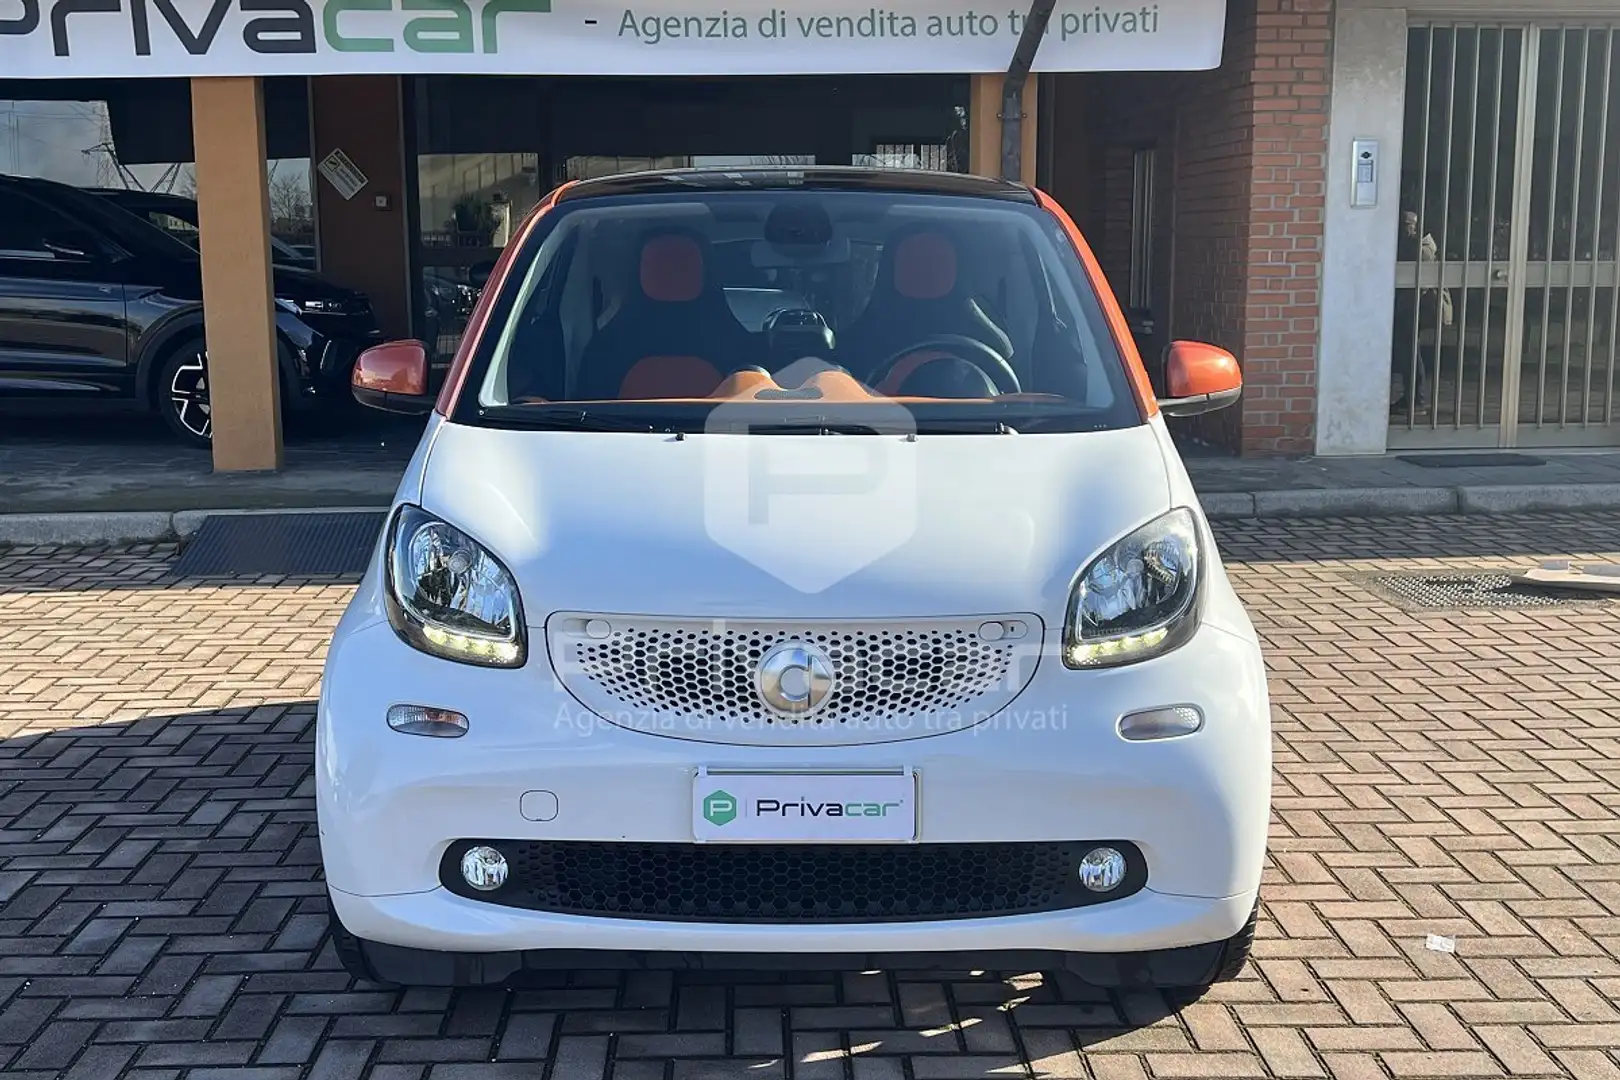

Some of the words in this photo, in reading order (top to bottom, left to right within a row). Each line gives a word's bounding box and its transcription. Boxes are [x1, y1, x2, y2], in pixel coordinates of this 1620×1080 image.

[618, 9, 748, 45] Agenzia
[757, 8, 787, 38] di
[796, 8, 917, 38] vendita
[926, 10, 999, 37] auto
[1060, 5, 1159, 42] privati
[756, 796, 900, 817] Privacar
